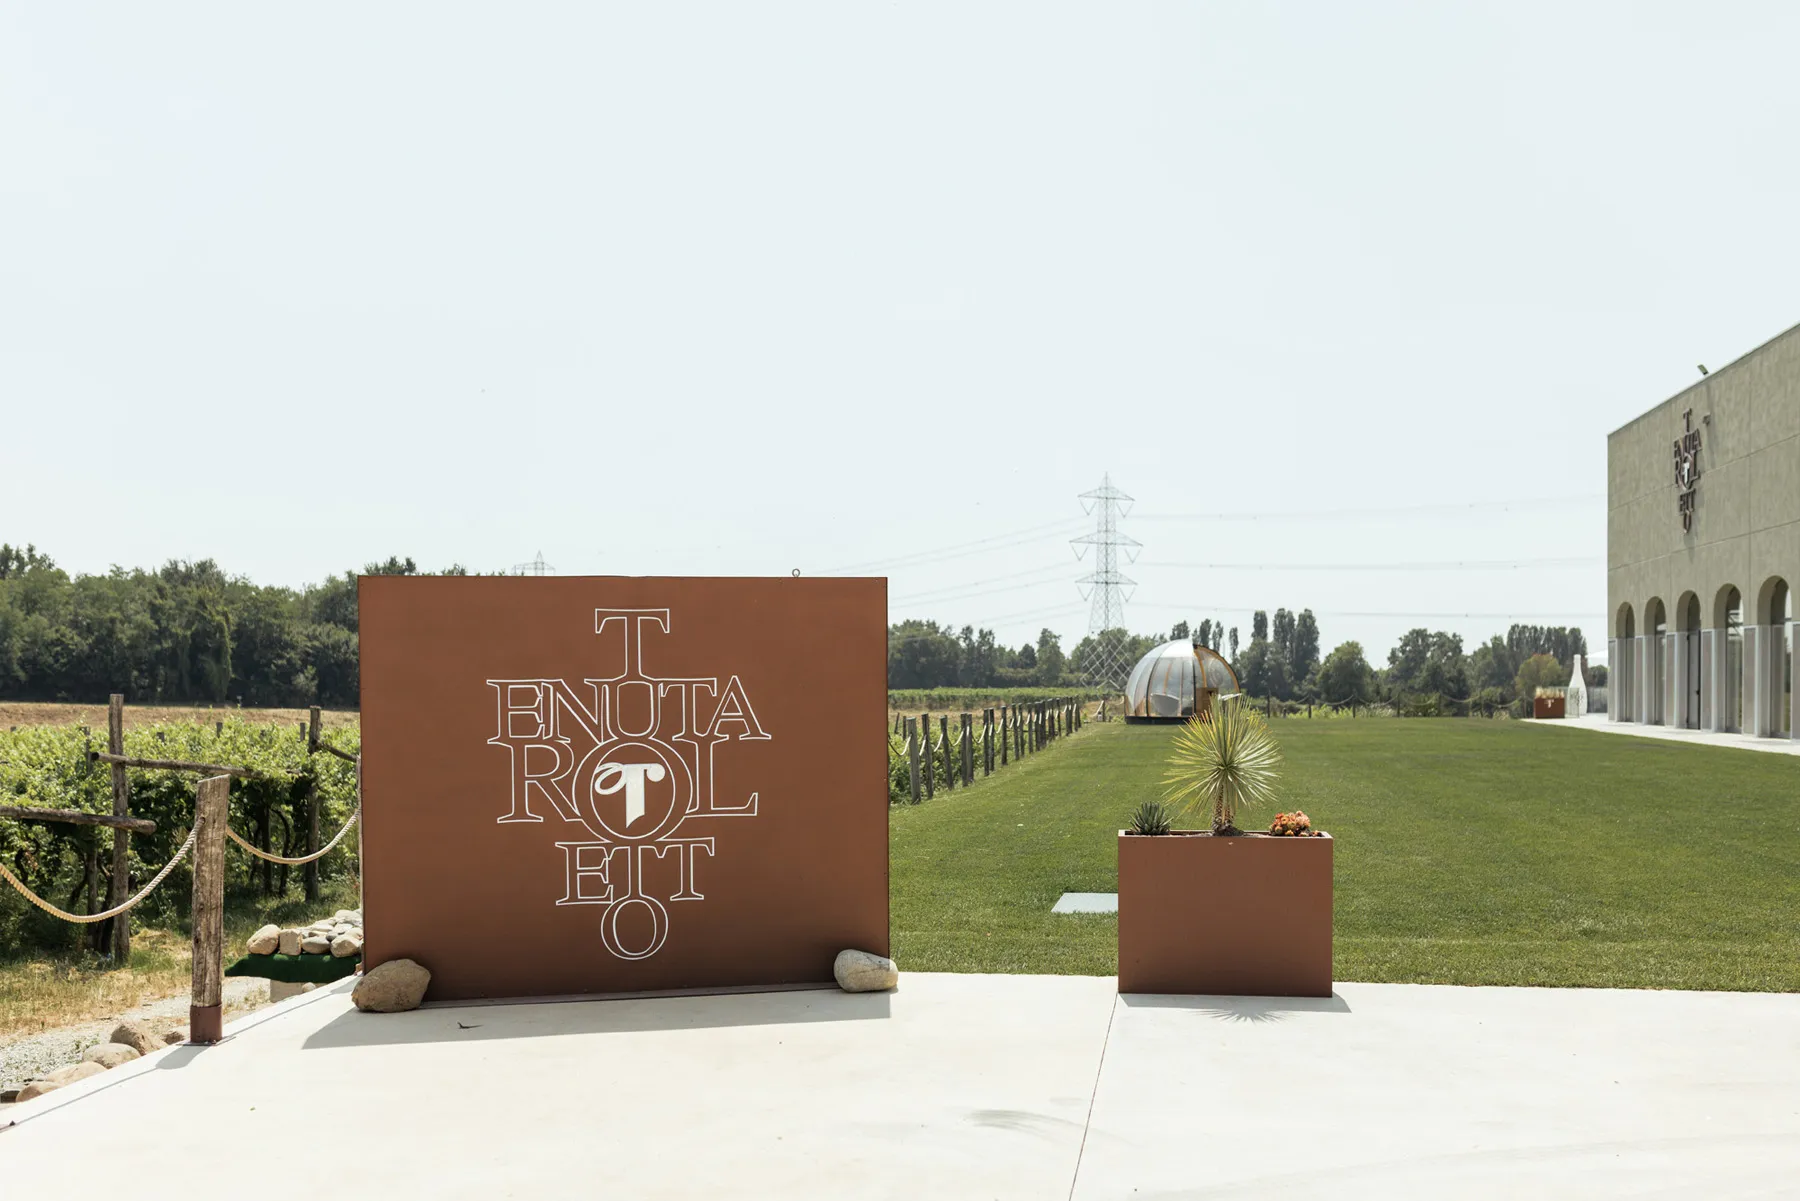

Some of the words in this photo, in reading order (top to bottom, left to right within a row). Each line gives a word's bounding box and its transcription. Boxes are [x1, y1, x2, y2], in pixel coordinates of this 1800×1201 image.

[595, 608, 670, 681] T
[486, 675, 772, 745] ENUTA
[555, 837, 714, 905] ETT
[601, 897, 669, 960] O
